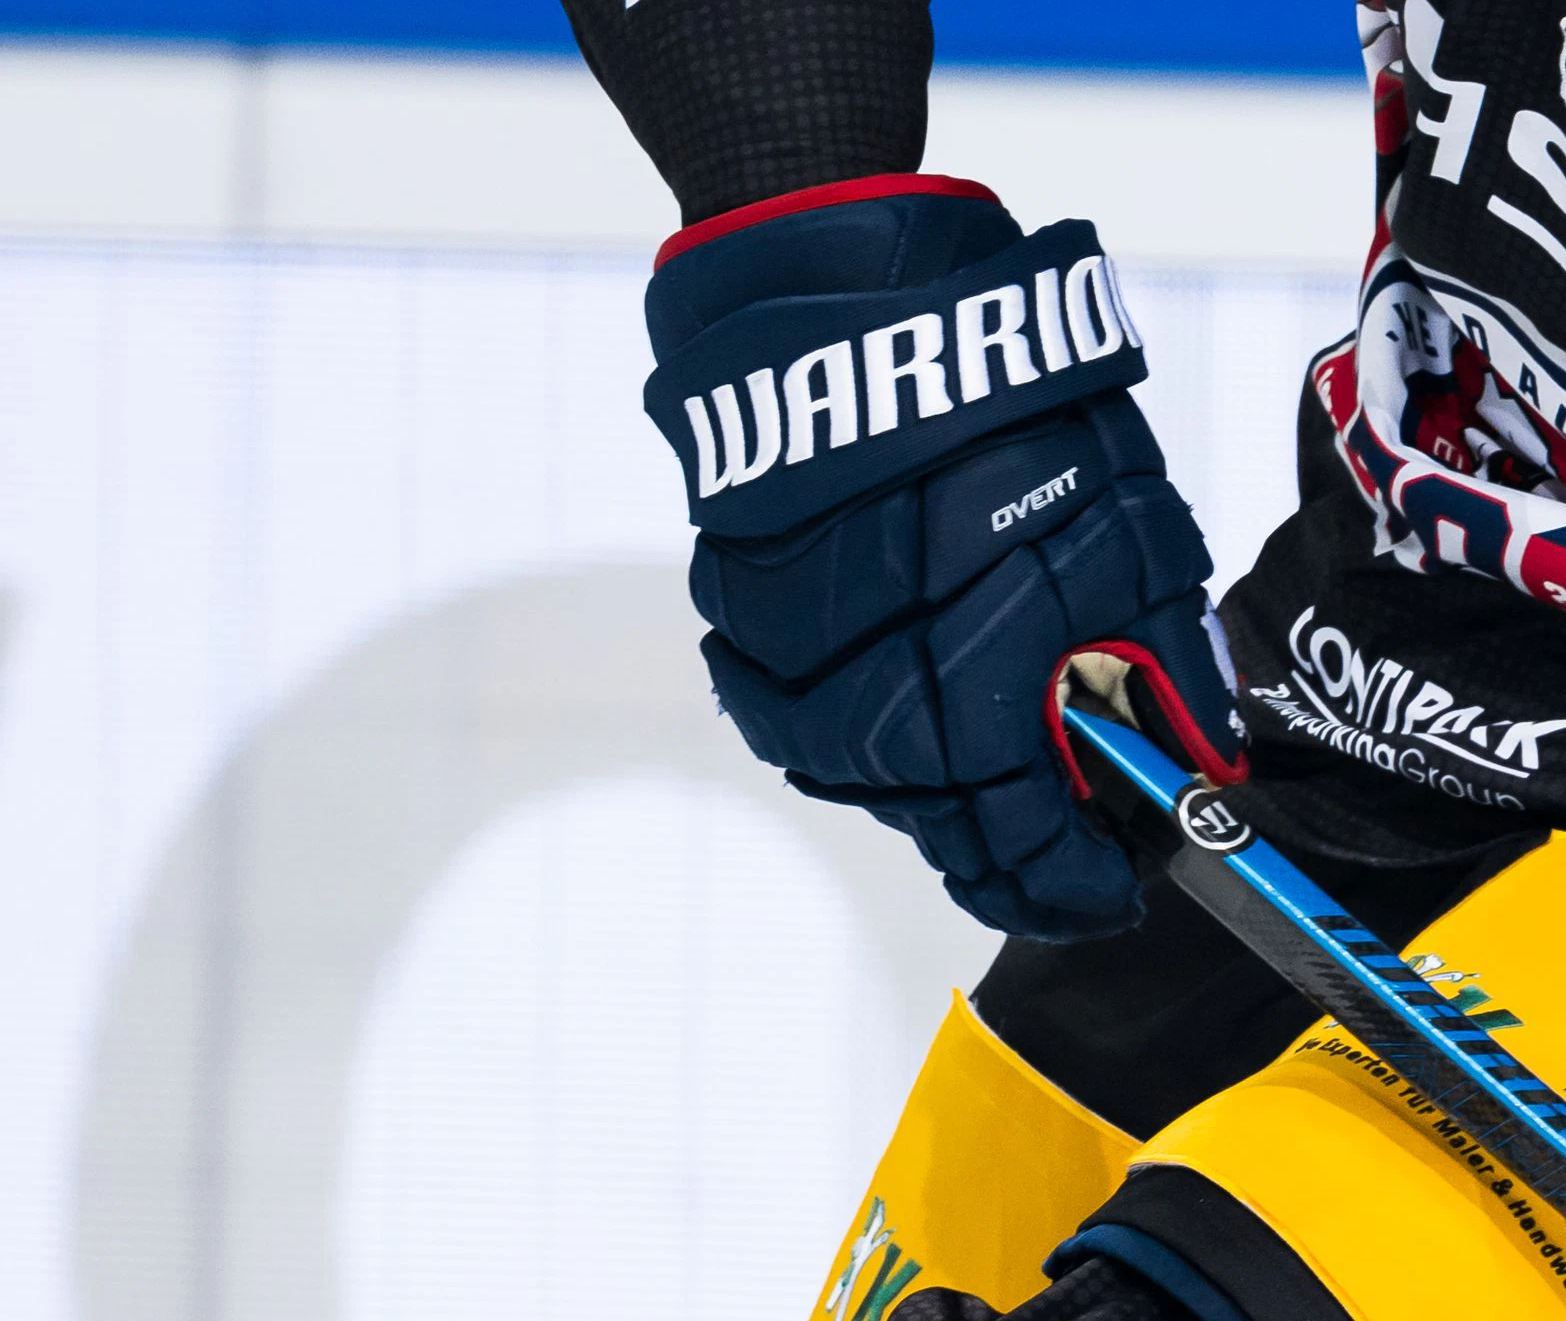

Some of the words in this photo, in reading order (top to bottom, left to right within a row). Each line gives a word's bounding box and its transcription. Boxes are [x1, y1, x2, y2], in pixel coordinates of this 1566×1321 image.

[991, 466, 1079, 532] OVERT
[1318, 1037, 1400, 1087] Experten
[1431, 1118, 1496, 1175] Maler
[1490, 1178, 1513, 1197] &
